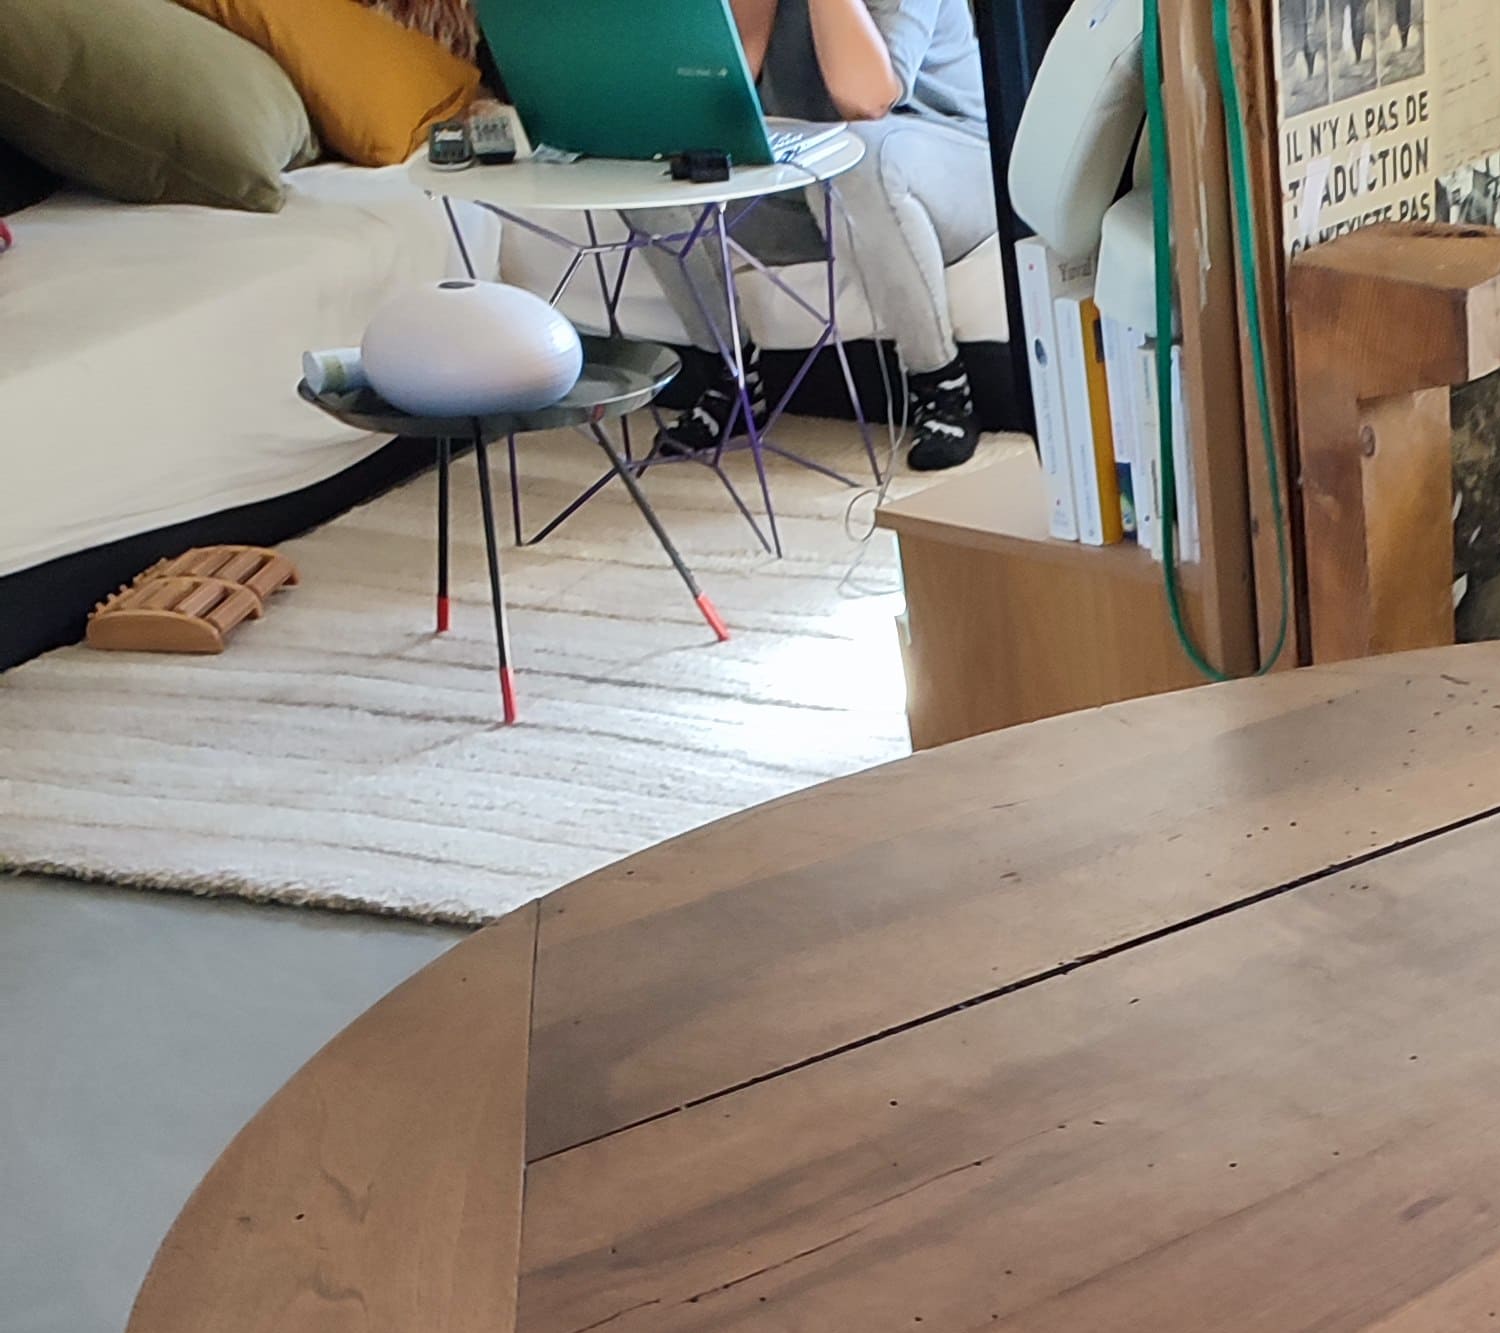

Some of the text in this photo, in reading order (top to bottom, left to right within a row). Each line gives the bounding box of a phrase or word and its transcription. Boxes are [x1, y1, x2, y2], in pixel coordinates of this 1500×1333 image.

[1286, 130, 1303, 166] IL
[1310, 116, 1339, 157] N'Y
[1346, 113, 1360, 145] A
[1364, 100, 1399, 138] PAS
[1406, 90, 1429, 126] DE
[1288, 136, 1429, 219] TADUCTION
[1399, 192, 1431, 222] PAS
